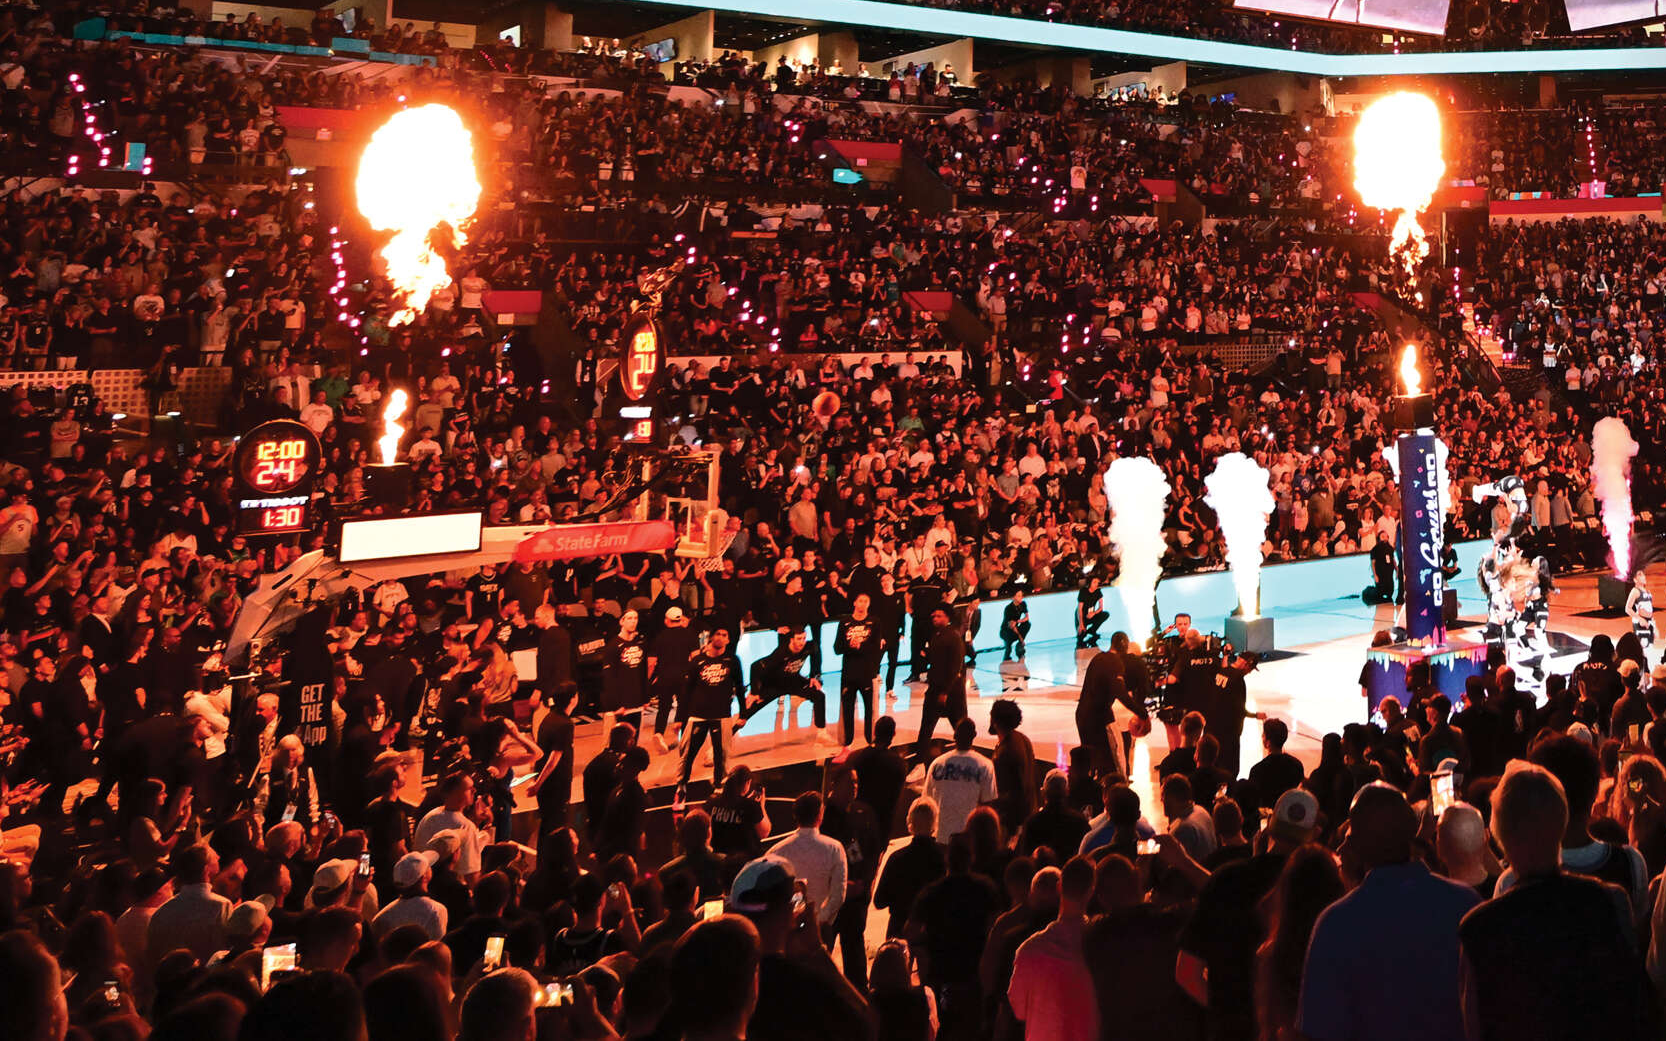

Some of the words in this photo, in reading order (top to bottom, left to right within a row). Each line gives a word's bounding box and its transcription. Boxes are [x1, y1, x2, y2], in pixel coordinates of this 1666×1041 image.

[257, 440, 306, 460] 12:00
[256, 460, 296, 485] 24
[1425, 453, 1437, 487] GO
[264, 507, 301, 527] 1:30
[1432, 571, 1443, 607] GO
[301, 683, 325, 704] GET
[300, 703, 324, 723] THE
[303, 724, 327, 746] App
